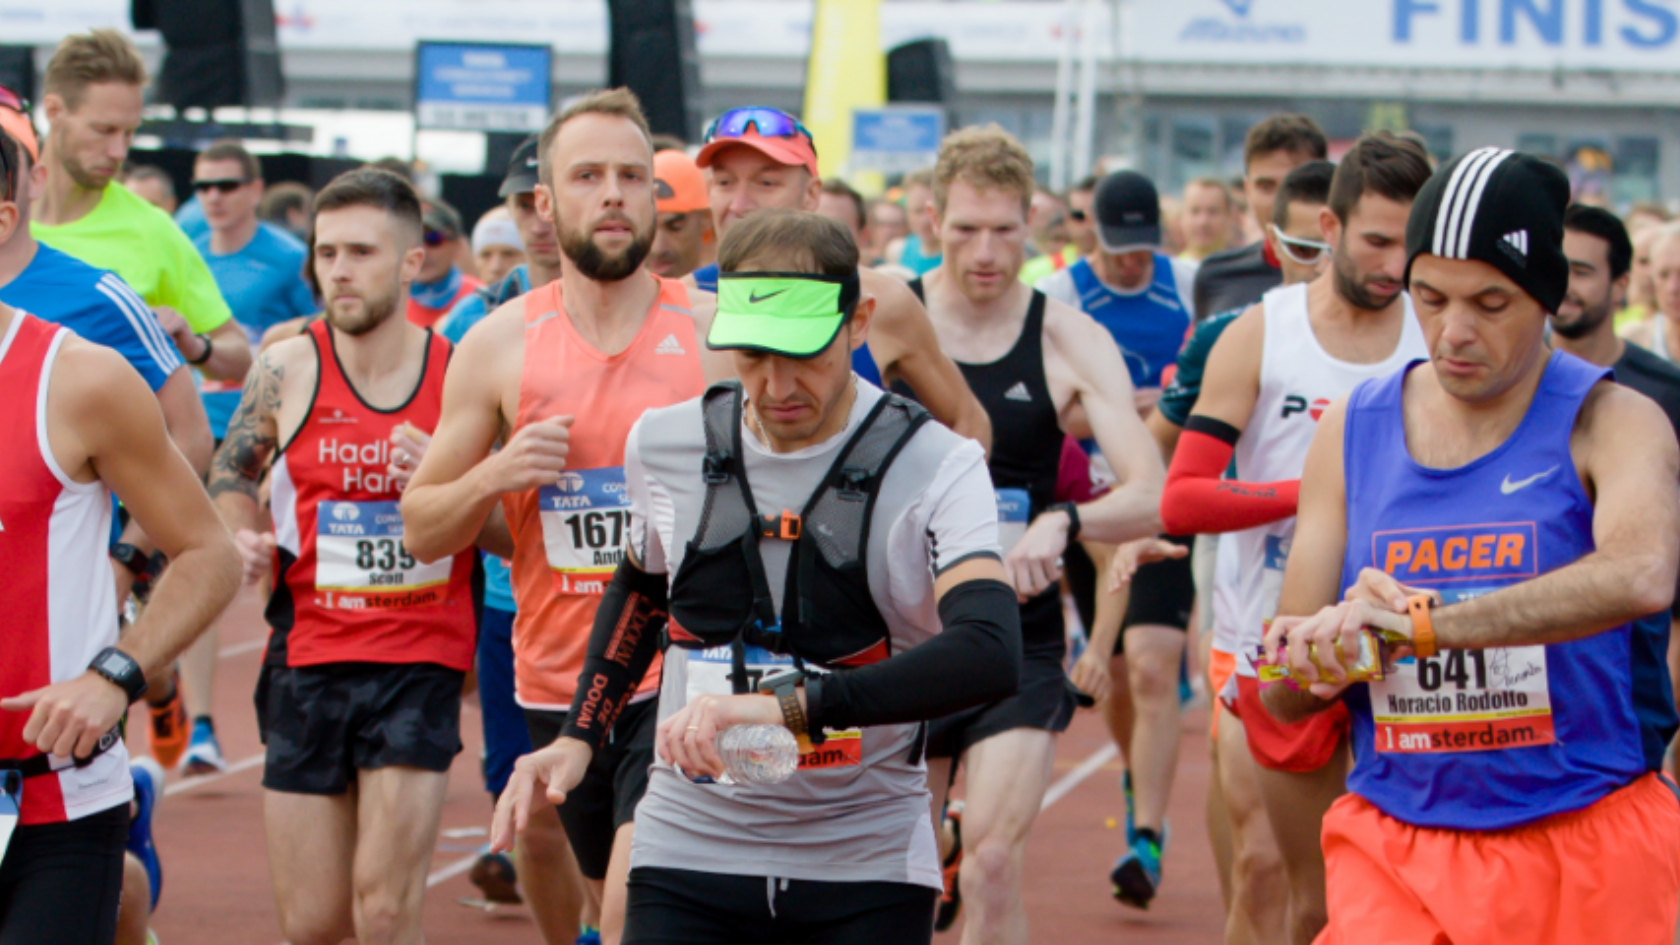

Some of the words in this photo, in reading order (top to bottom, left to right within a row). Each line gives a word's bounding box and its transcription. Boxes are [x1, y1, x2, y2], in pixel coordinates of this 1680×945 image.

[552, 496, 592, 508] TATA
[328, 523, 365, 535] TATA
[1384, 533, 1525, 575] PACER
[1417, 648, 1487, 692] 641
[576, 672, 609, 730] DOUAI
